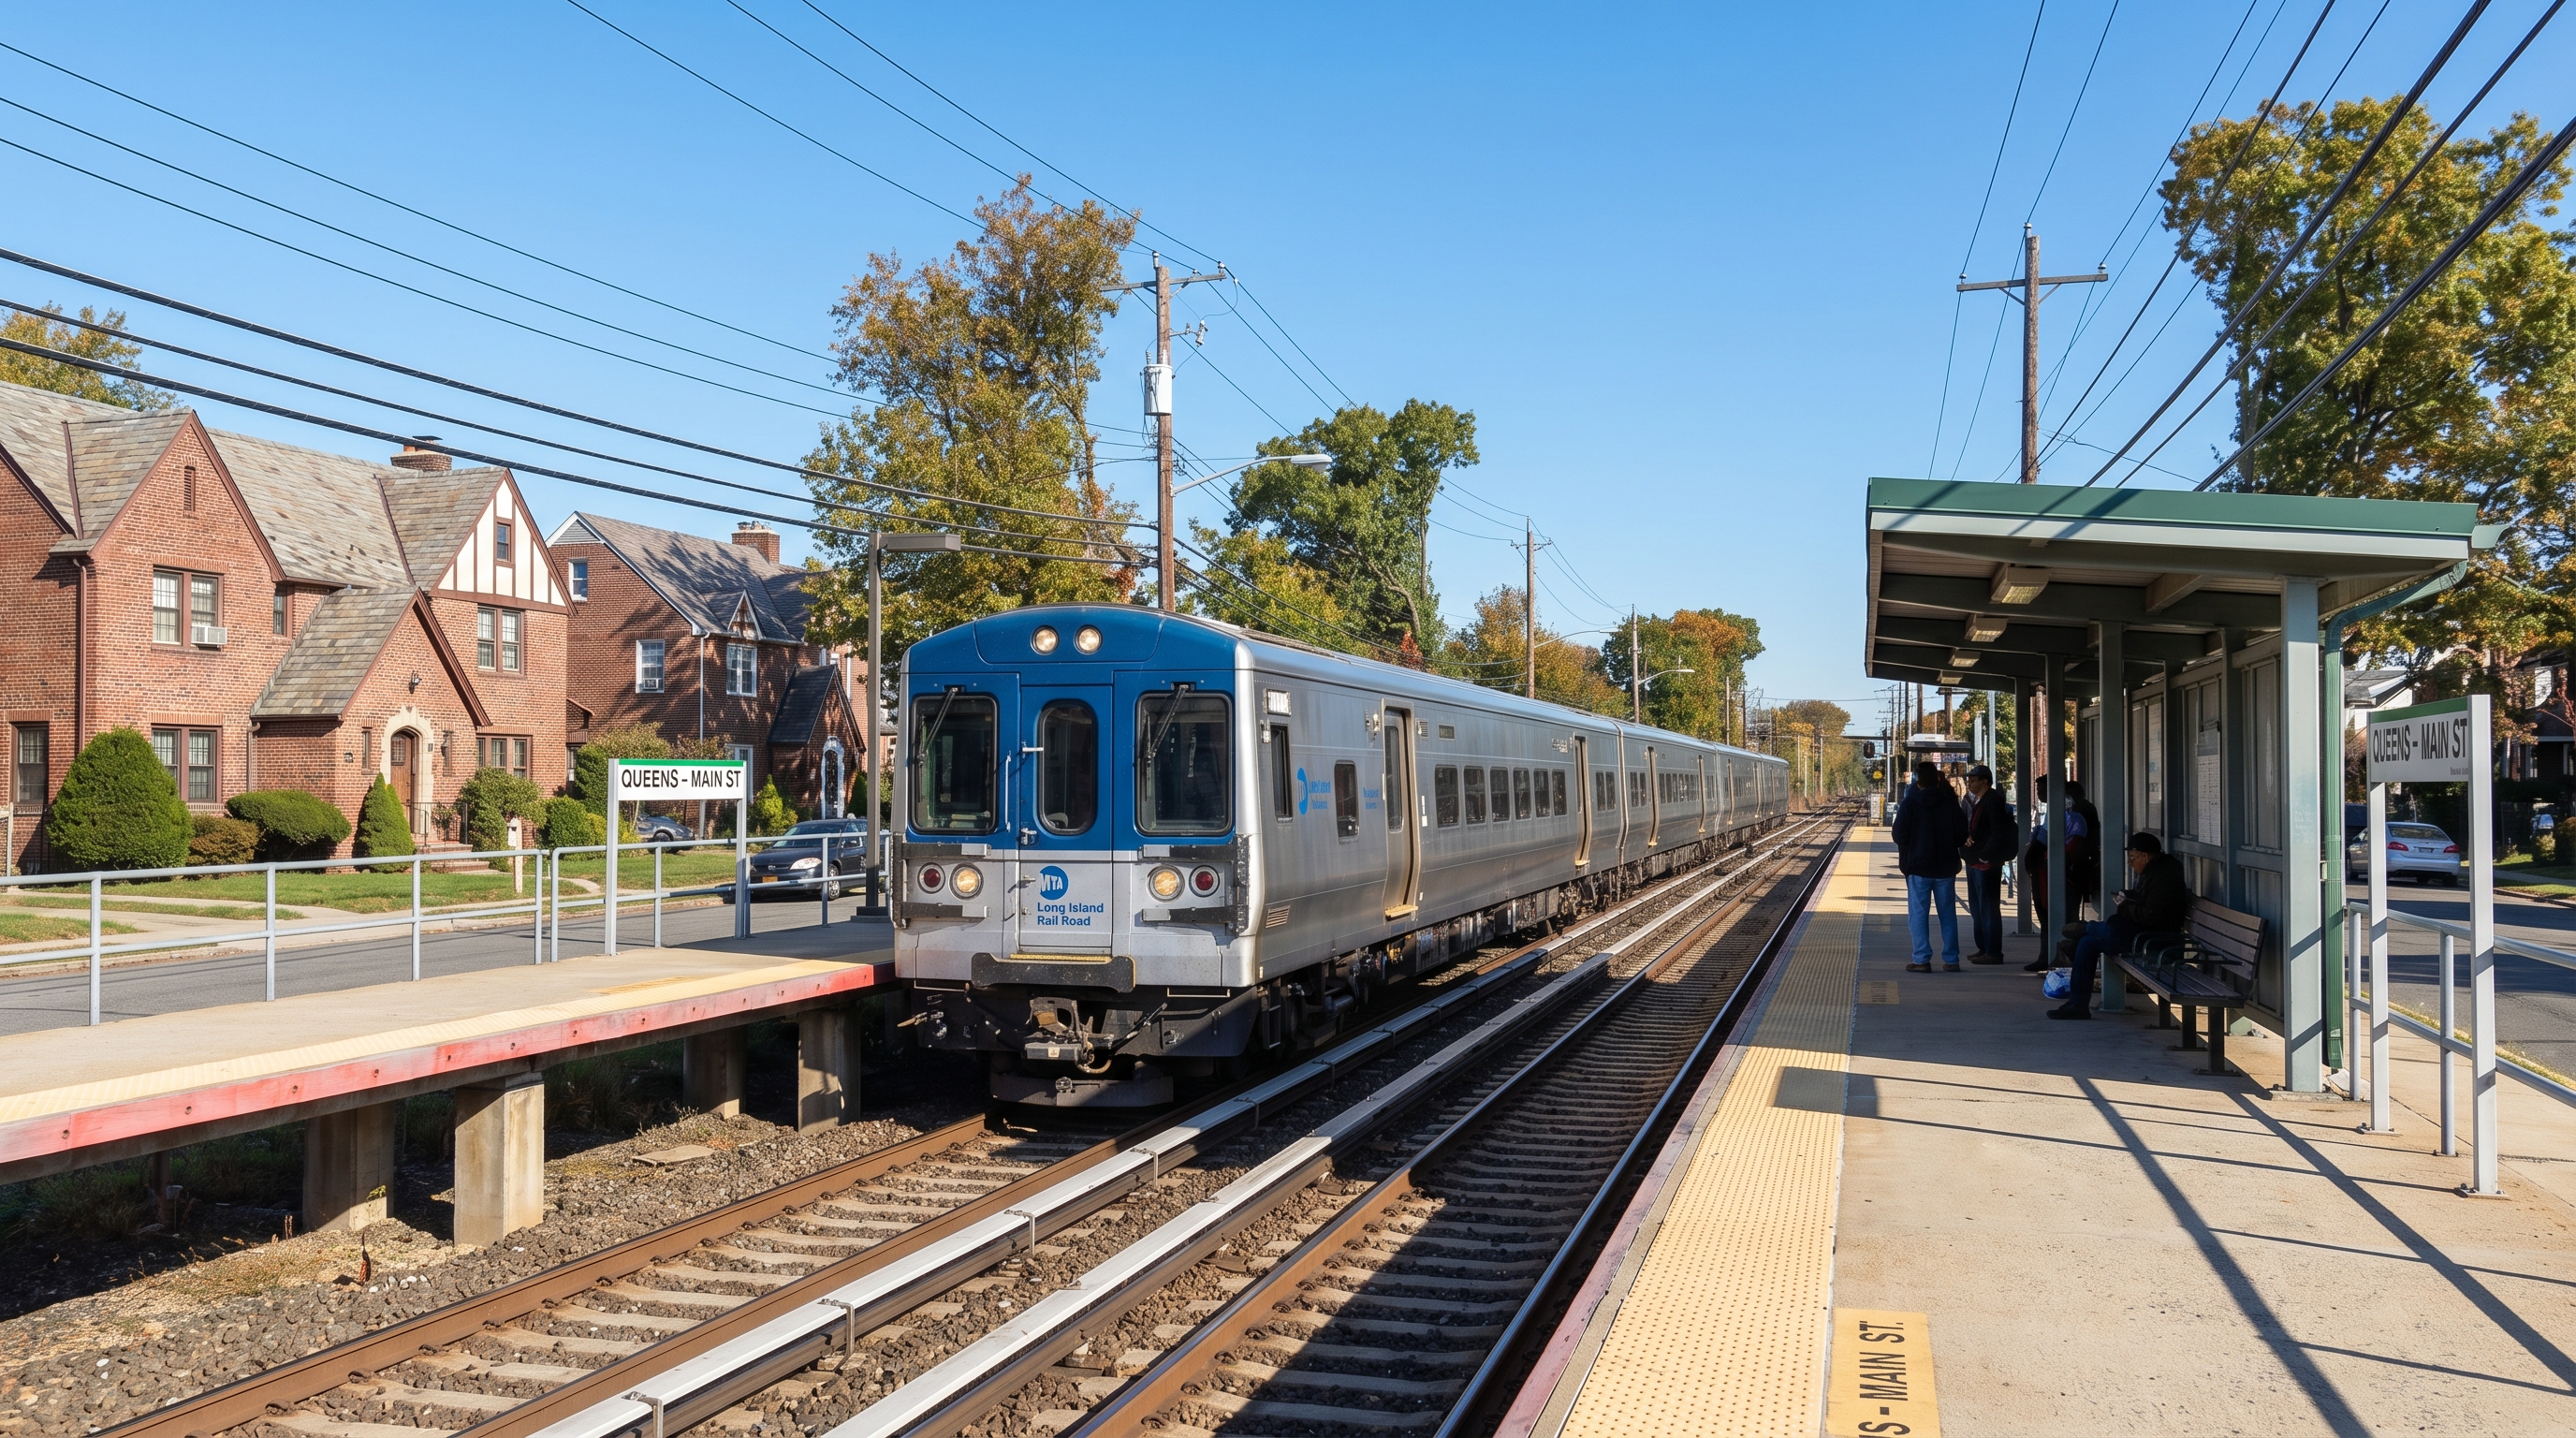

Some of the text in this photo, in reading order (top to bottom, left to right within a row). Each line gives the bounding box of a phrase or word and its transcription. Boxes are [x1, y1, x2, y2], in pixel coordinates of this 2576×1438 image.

[2373, 724, 2410, 763] QUEENS
[2421, 721, 2449, 759] MAIN
[2452, 718, 2467, 758] ST
[622, 769, 679, 788] QUEENS
[691, 770, 723, 787] MAIN
[725, 770, 741, 787] ST
[1037, 902, 1104, 915] Long Island
[1037, 916, 1090, 926] Rail Road
[1859, 1352, 1909, 1401] MAIN
